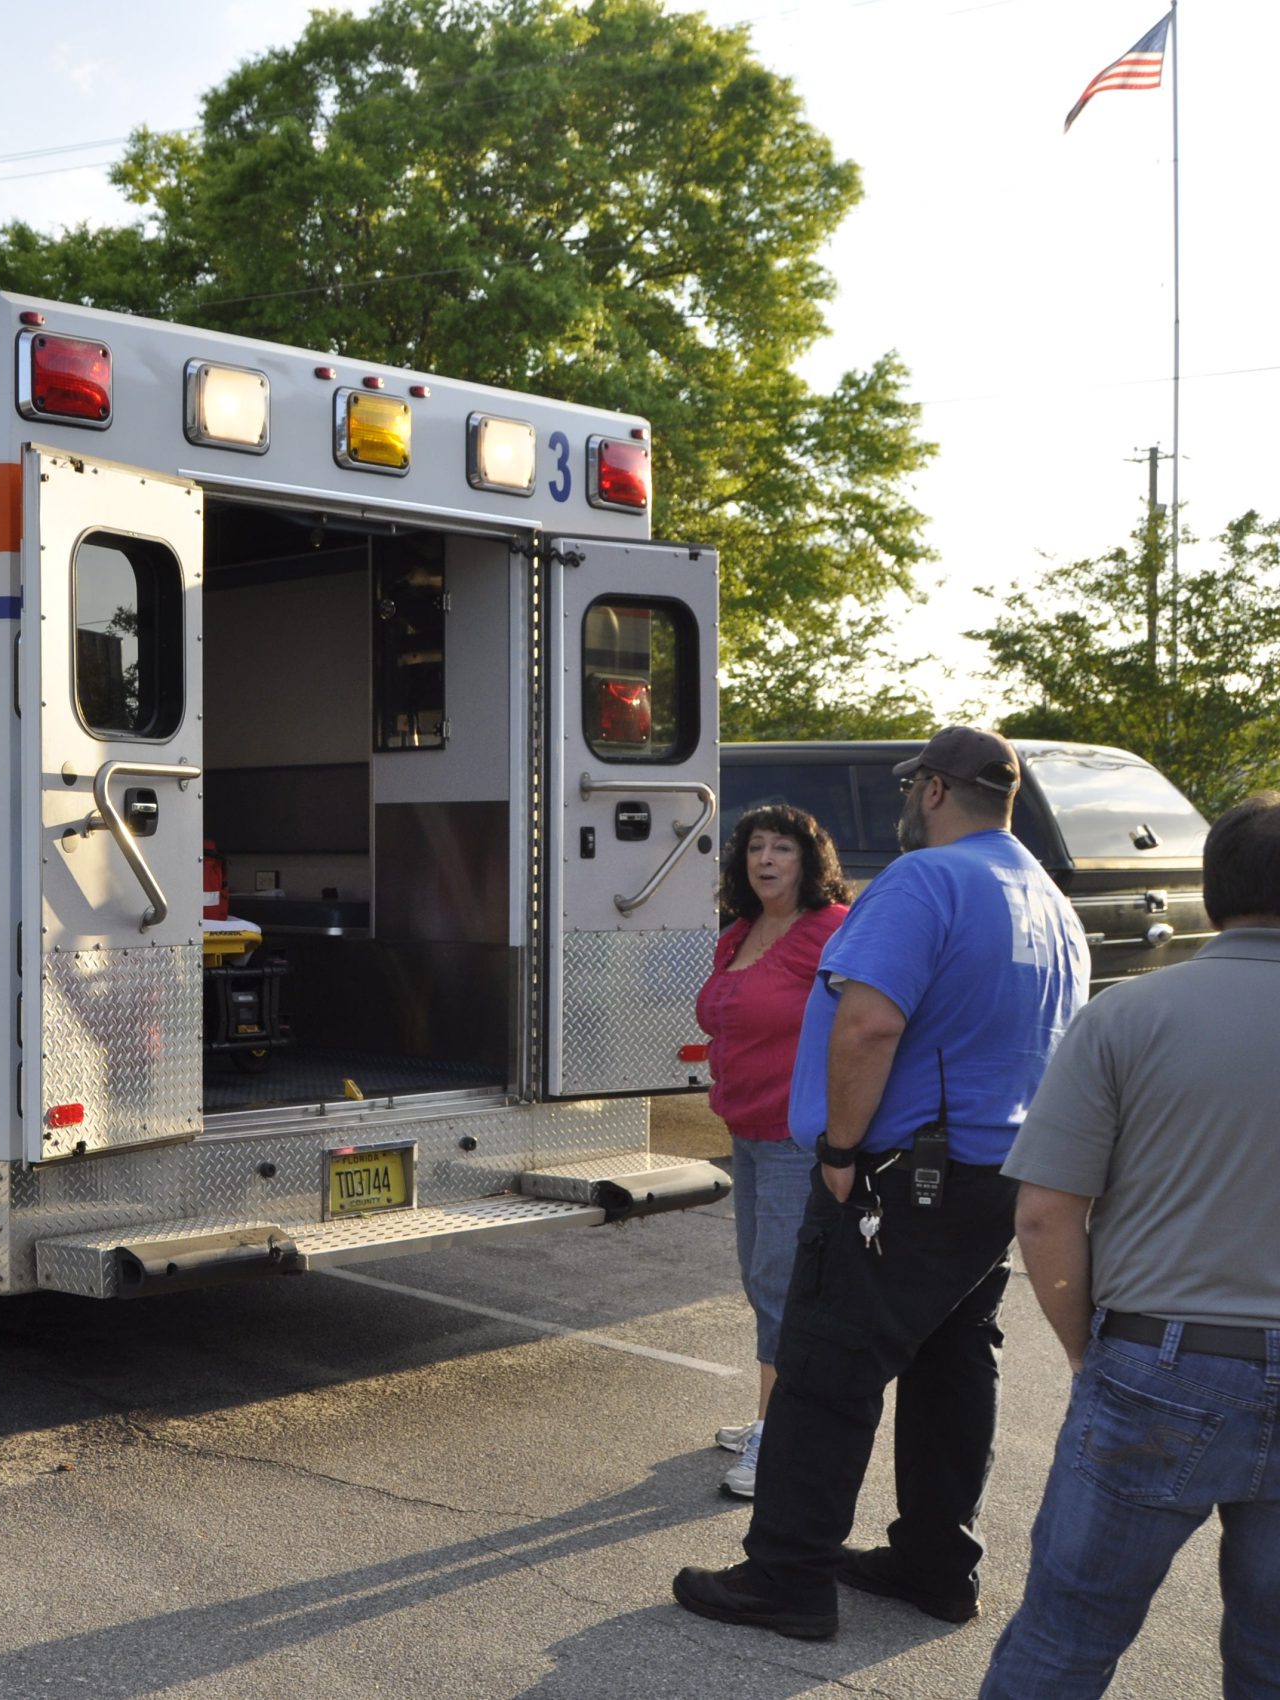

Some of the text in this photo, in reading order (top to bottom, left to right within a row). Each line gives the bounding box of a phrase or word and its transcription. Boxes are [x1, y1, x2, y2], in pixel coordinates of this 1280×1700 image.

[548, 431, 571, 502] 3
[342, 1153, 380, 1165] FLORIDA
[335, 1166, 391, 1199] TD3744
[350, 1197, 381, 1207] COUNTY
